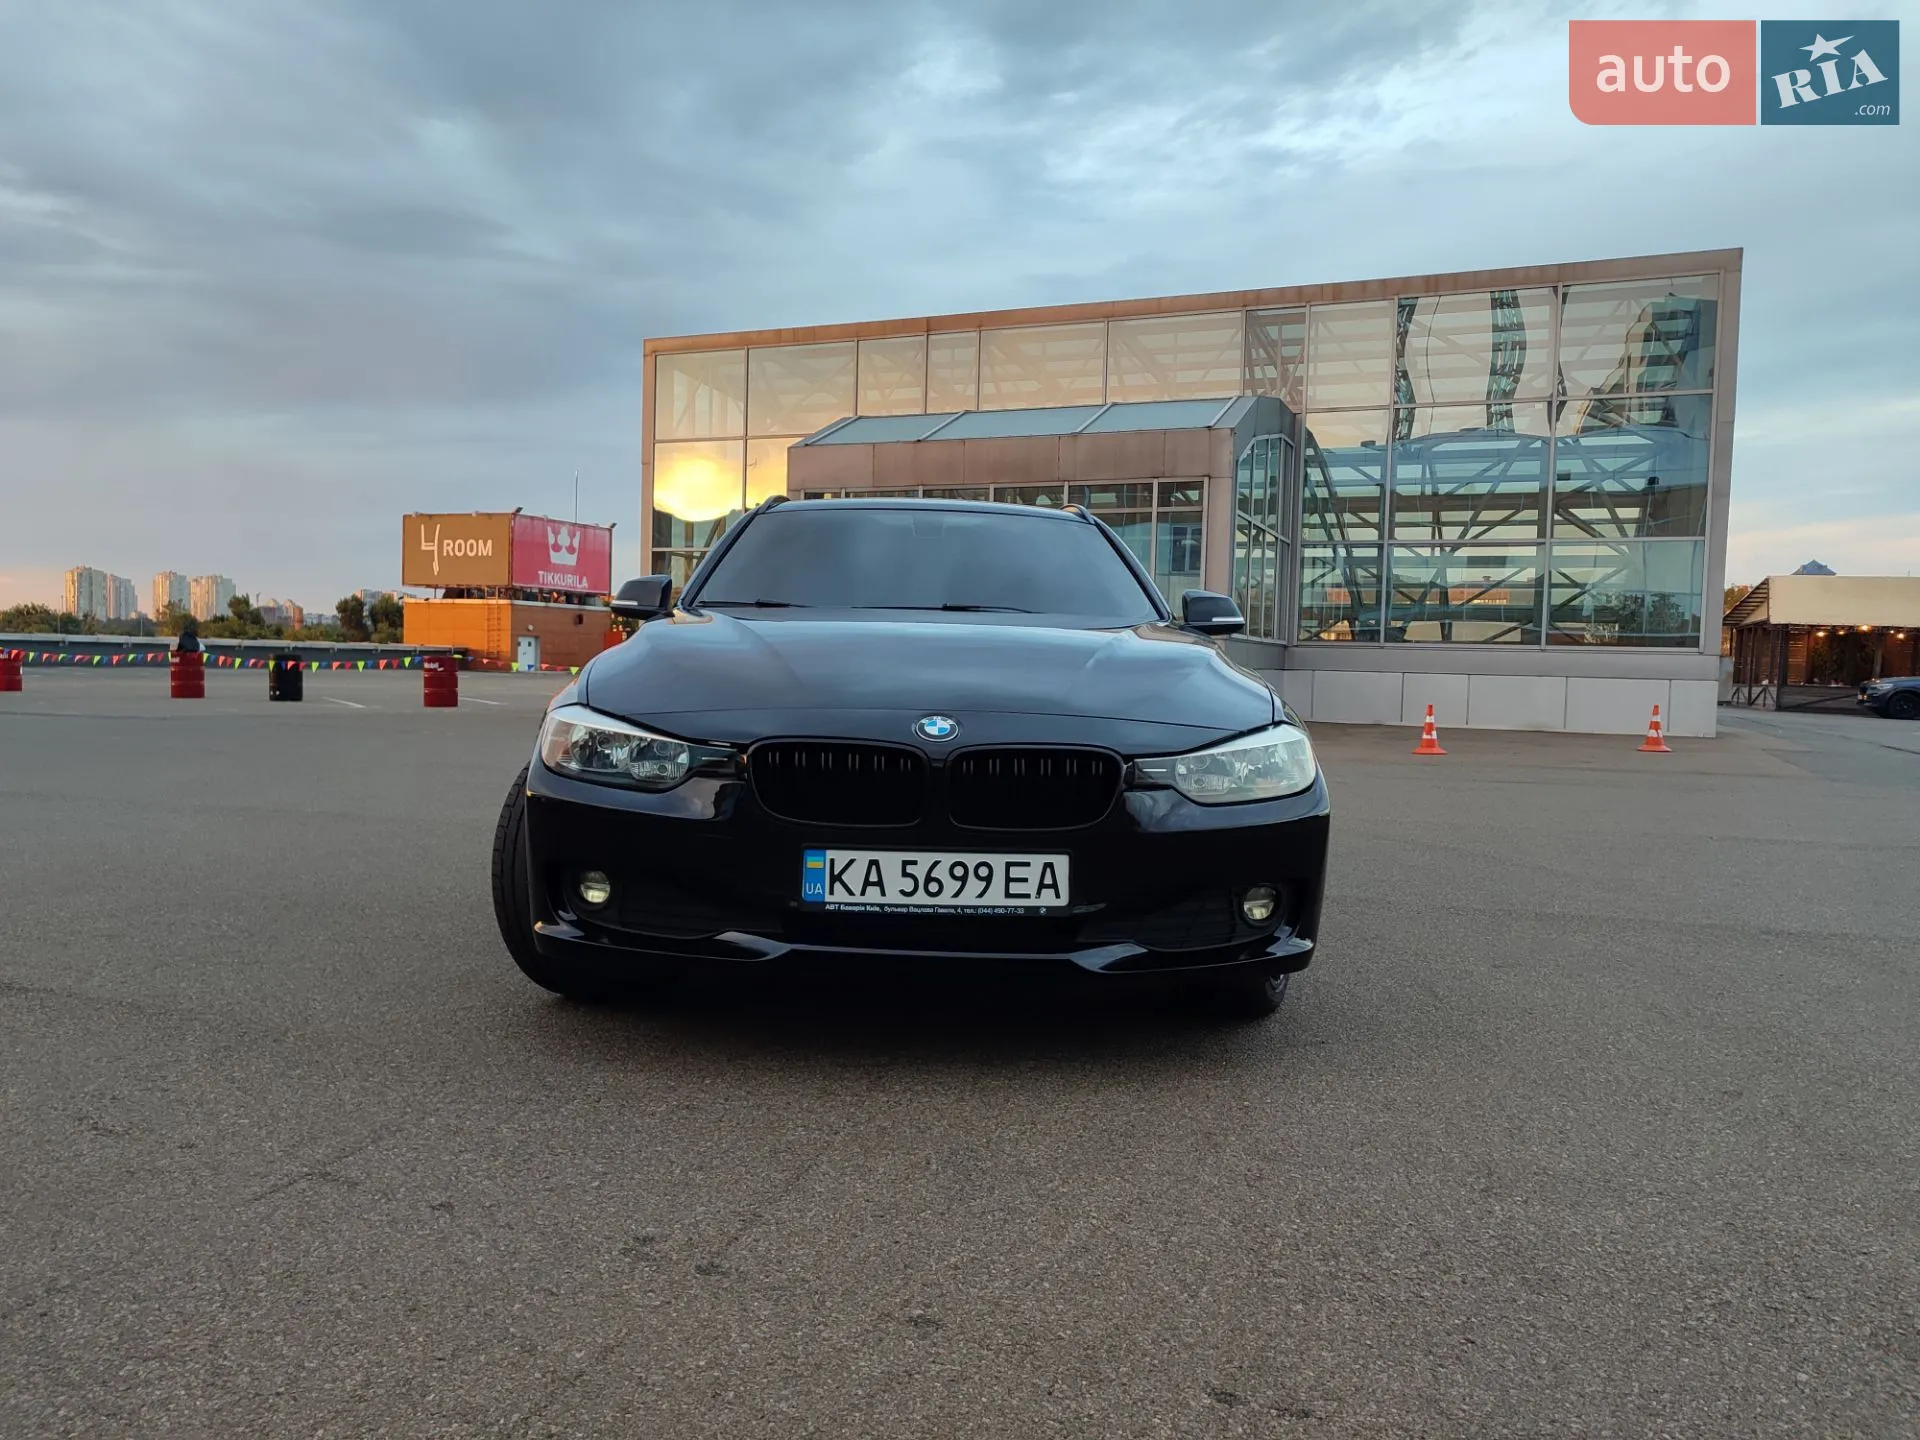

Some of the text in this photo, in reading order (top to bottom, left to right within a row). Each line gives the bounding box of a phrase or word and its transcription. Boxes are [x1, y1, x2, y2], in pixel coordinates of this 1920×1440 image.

[443, 539, 493, 557] ROOM
[538, 571, 588, 588] TIKKURILA
[828, 858, 1062, 900] KA 5699 EA
[806, 882, 823, 895] UA
